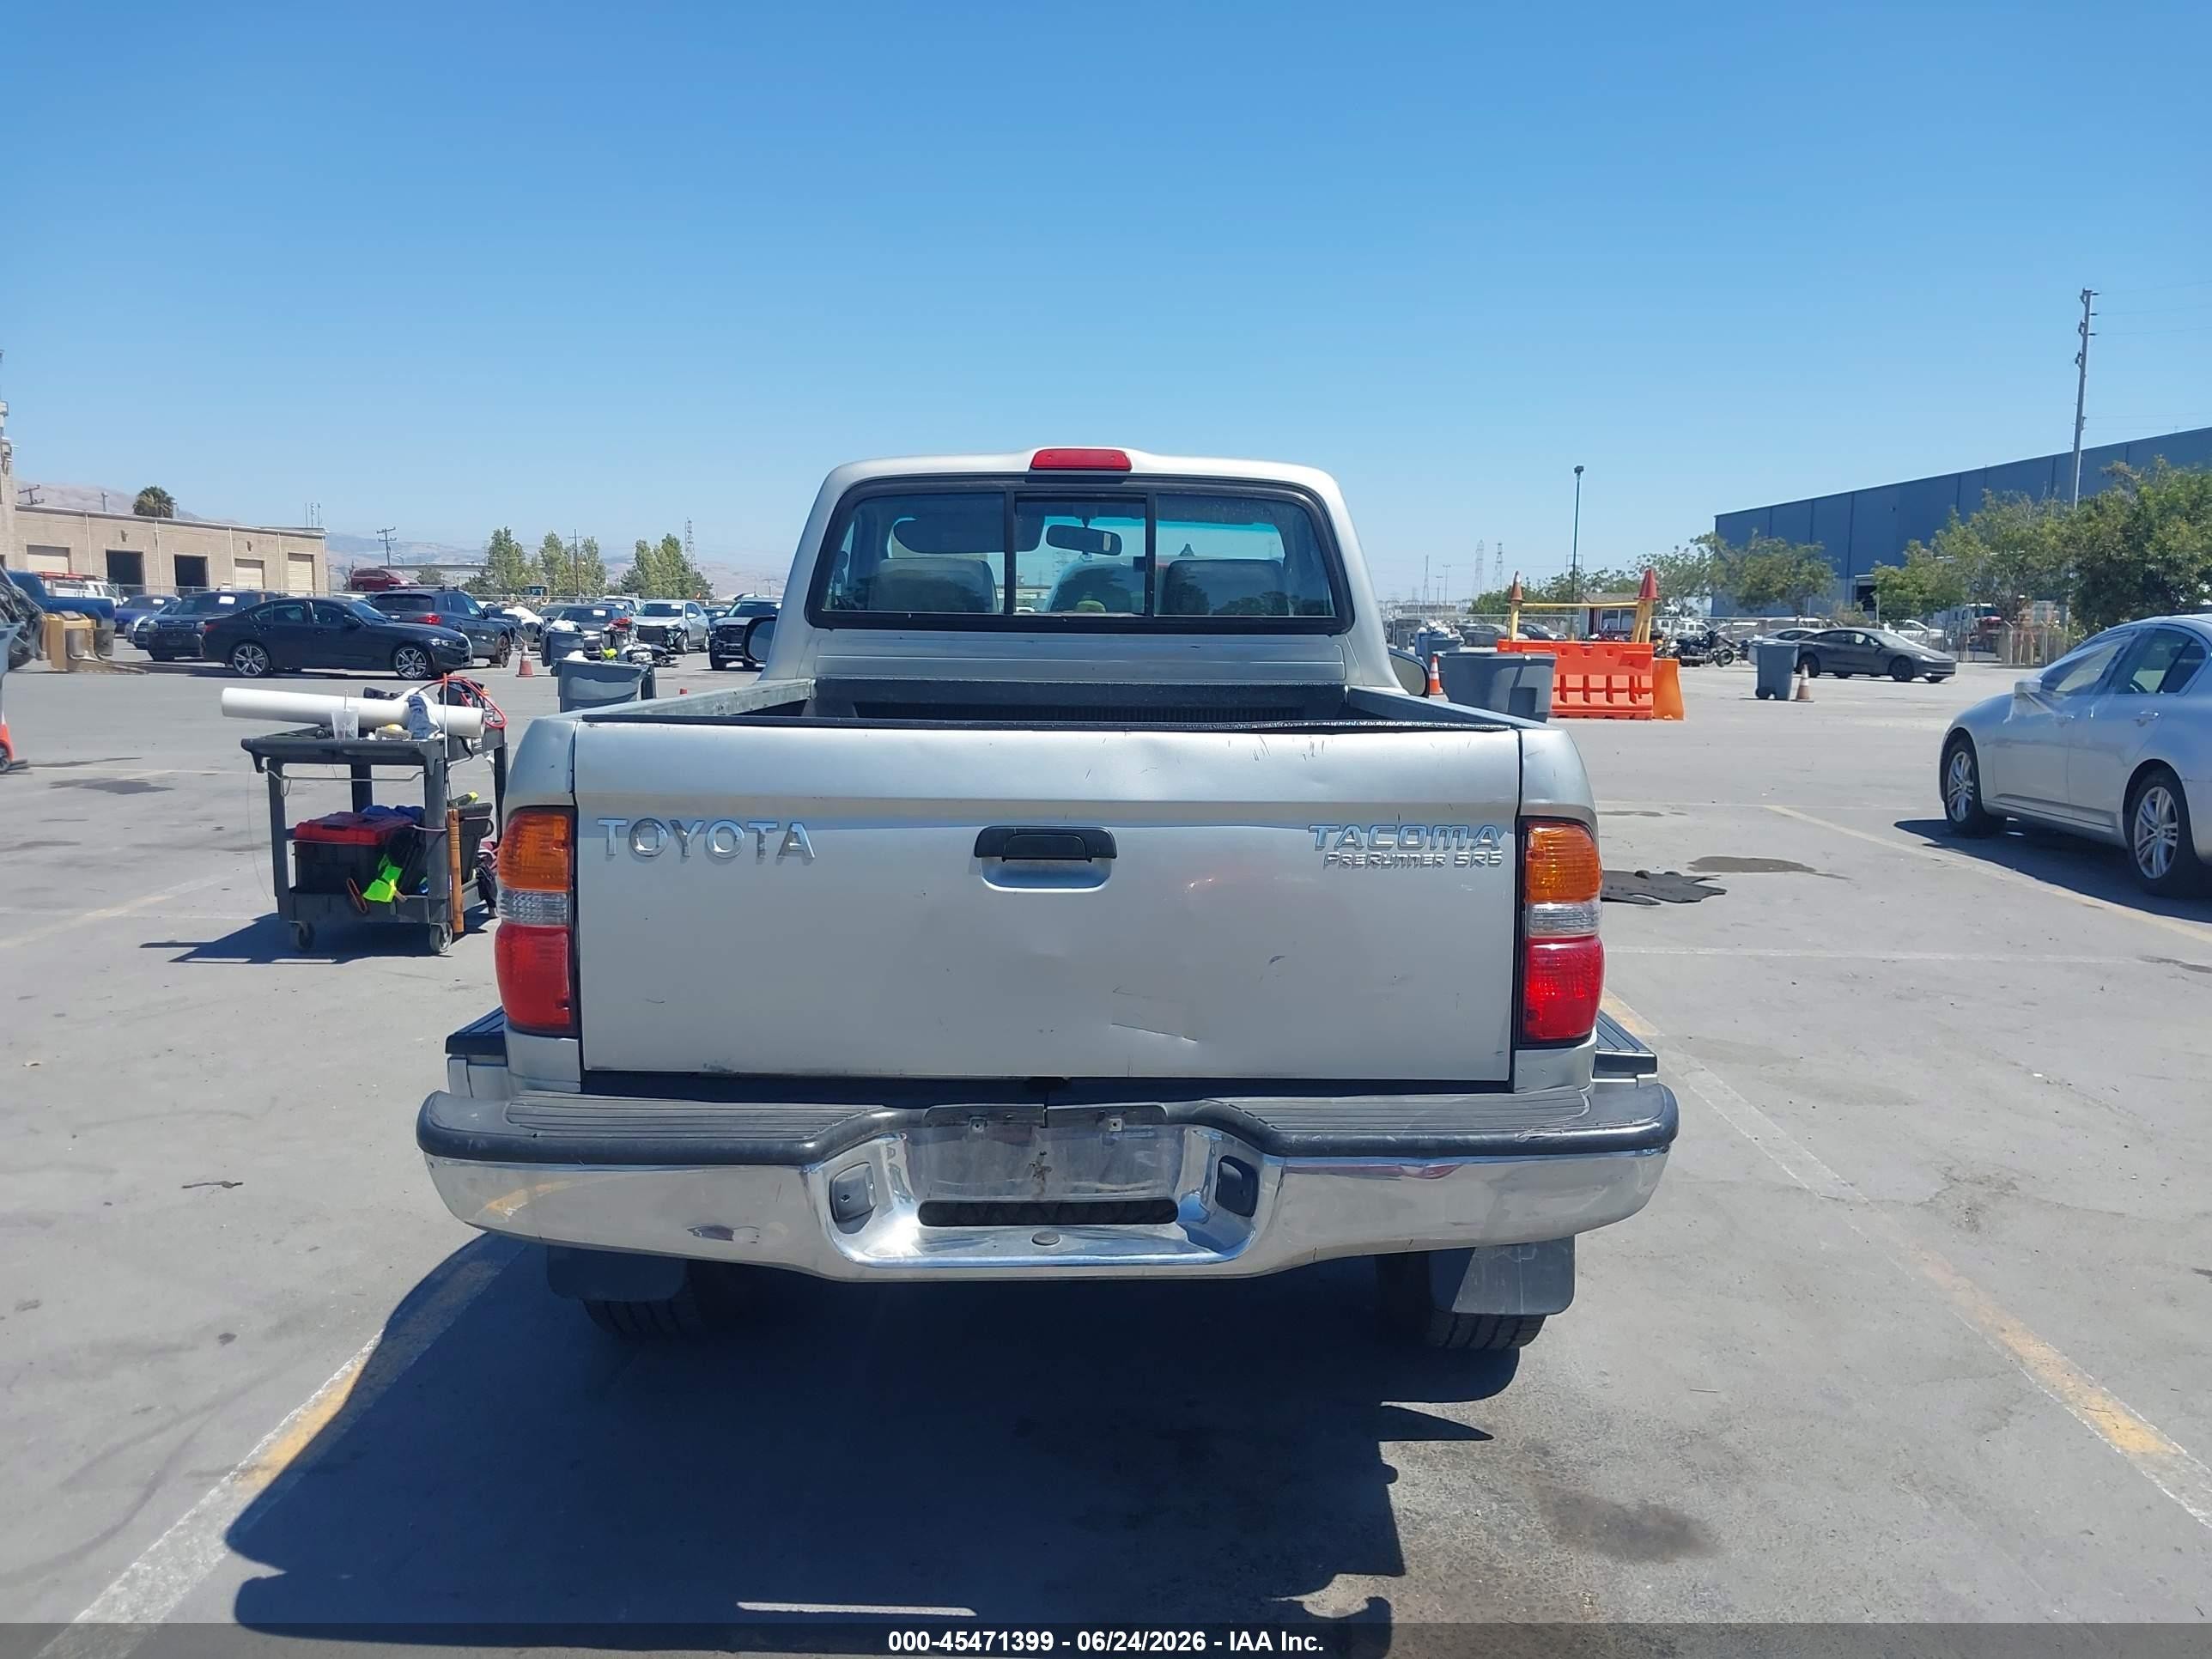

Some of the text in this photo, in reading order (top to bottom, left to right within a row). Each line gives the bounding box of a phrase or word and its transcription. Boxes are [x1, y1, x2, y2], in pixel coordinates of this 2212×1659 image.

[597, 817, 816, 860] TOYOTA
[1308, 824, 1501, 850] TACOMA
[1454, 850, 1504, 867] SR5
